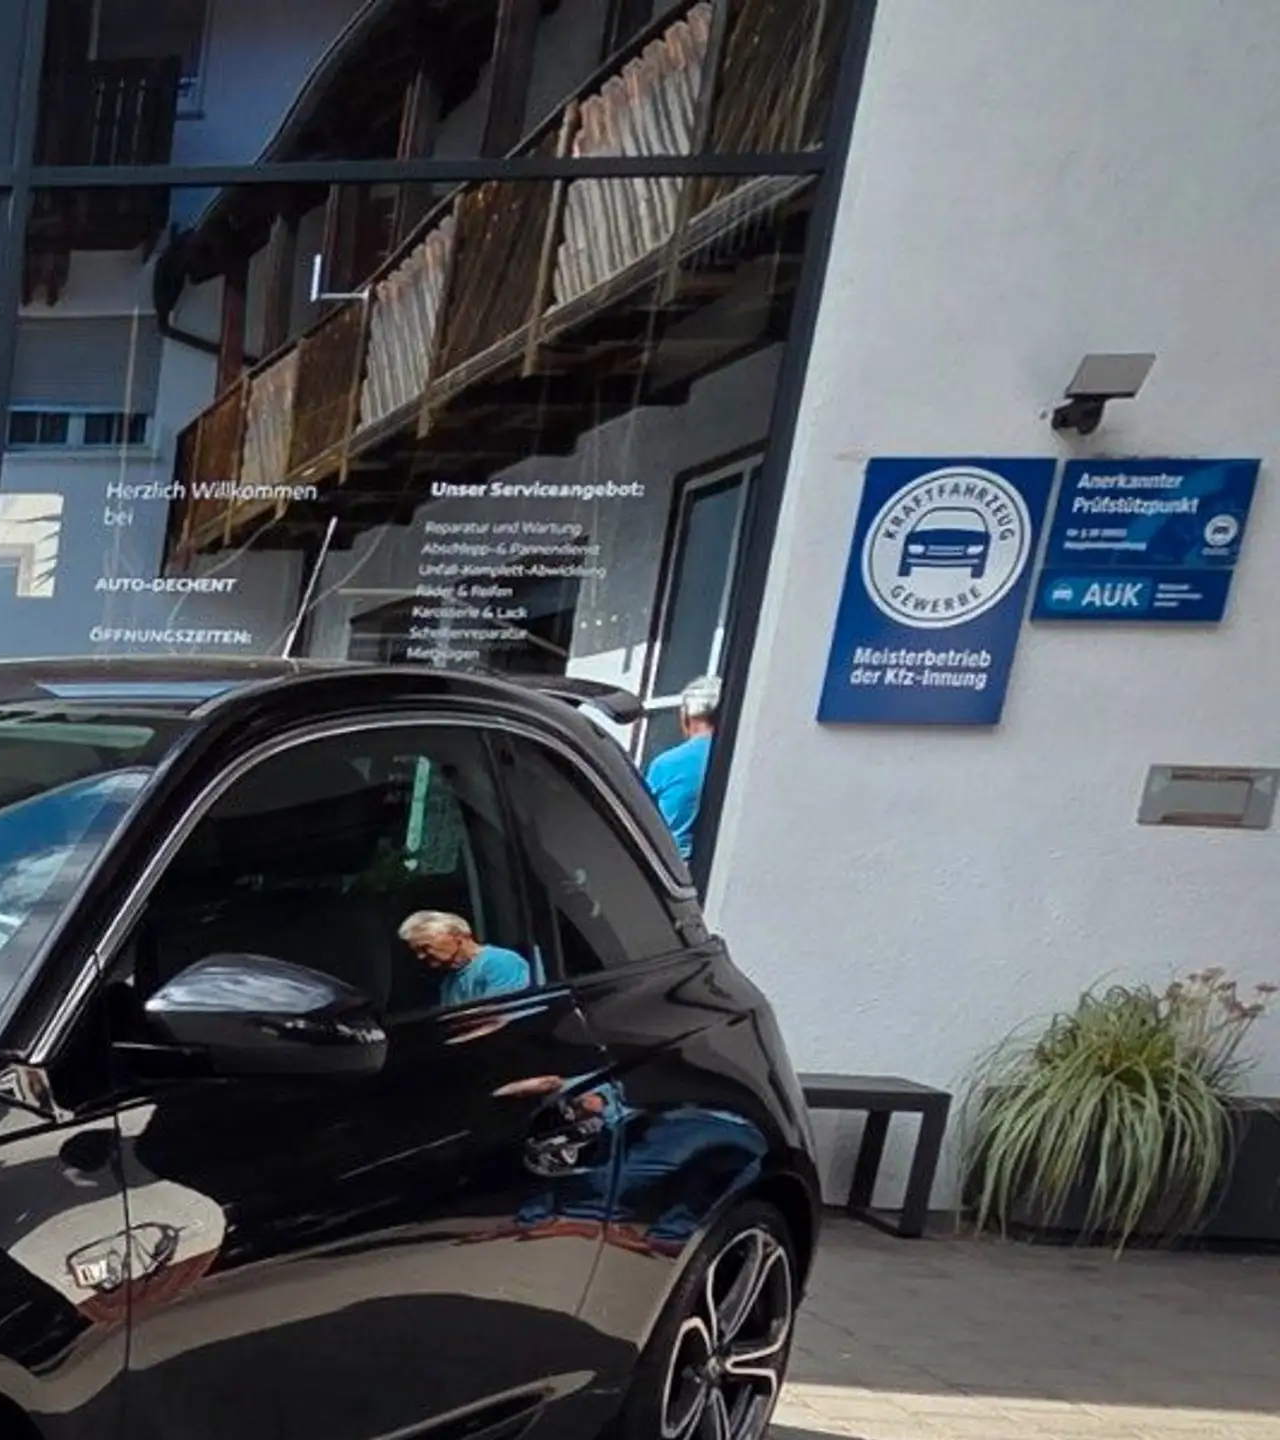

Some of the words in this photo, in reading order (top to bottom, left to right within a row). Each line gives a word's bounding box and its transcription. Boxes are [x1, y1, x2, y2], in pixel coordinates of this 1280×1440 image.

[106, 479, 186, 500] Herzlich
[191, 479, 318, 500] Willkommen
[1076, 472, 1184, 489] Anerkannter
[430, 481, 487, 498] Unser
[490, 481, 646, 501] Serviceangebot:
[103, 506, 134, 526] bei
[883, 482, 1015, 541] KRAFTFAHRZEUG
[1071, 496, 1200, 516] Prüfstützpunkt
[424, 521, 490, 536] Reparatur
[492, 521, 519, 534] und
[521, 521, 583, 537] Wartung
[95, 577, 239, 593] AUTO-DECHENT
[471, 584, 513, 598] Reifen
[1081, 582, 1143, 608] AUK
[890, 584, 983, 614] GEWERBE
[496, 605, 528, 619] Lack
[89, 624, 253, 645] ÖFFNUNGSZEITEN:
[853, 647, 991, 668] Meisterbetrieb
[850, 667, 880, 686] der
[884, 668, 989, 691] Kfz-Innung
